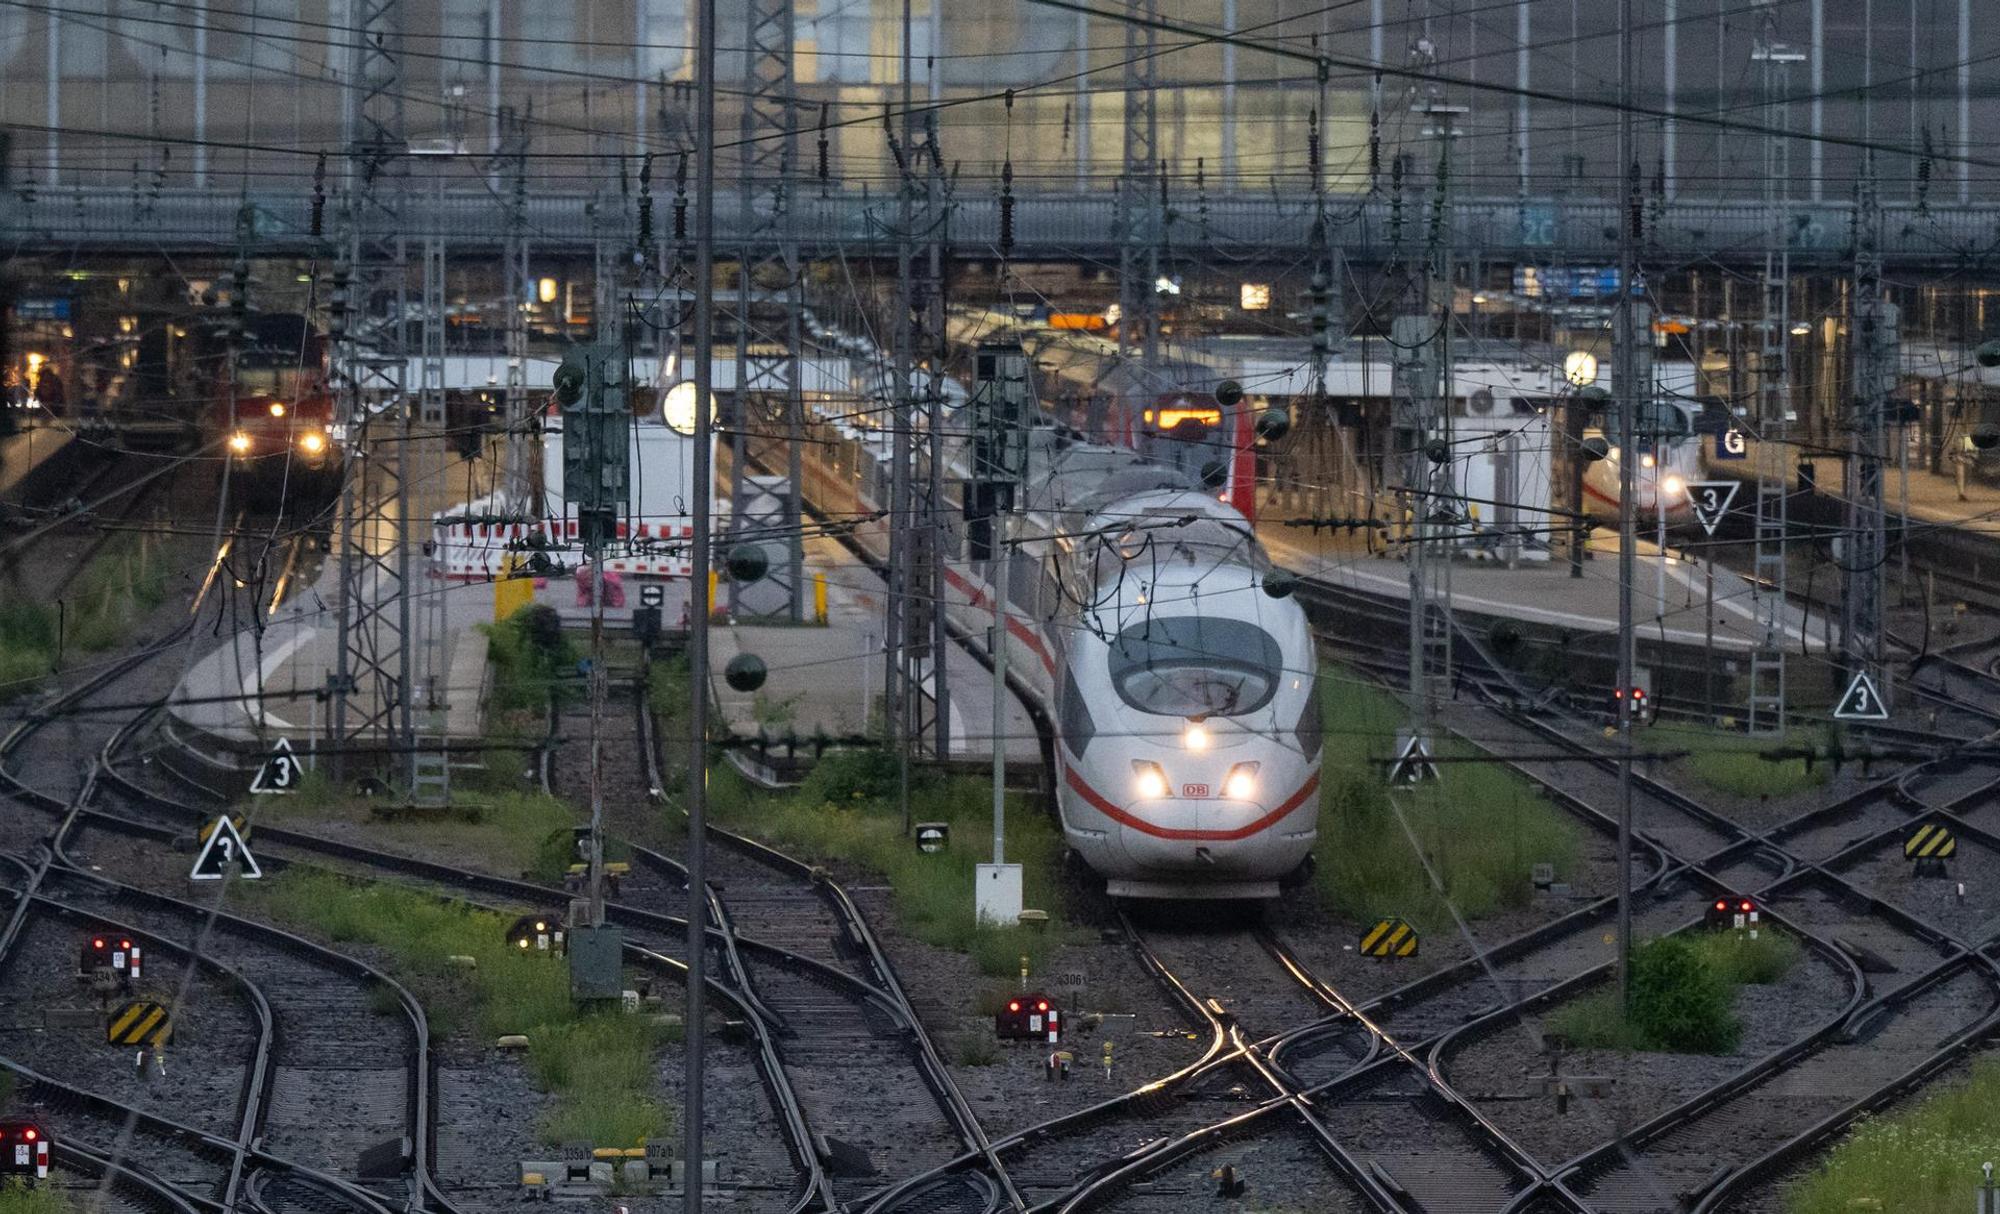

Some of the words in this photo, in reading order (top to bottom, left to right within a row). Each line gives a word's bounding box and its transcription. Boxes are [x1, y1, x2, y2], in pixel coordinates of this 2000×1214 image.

[1724, 428, 1745, 454] G
[1703, 489, 1717, 512] 3
[1855, 686, 1867, 712] 3
[275, 756, 290, 787] 3
[1185, 784, 1206, 796] DB
